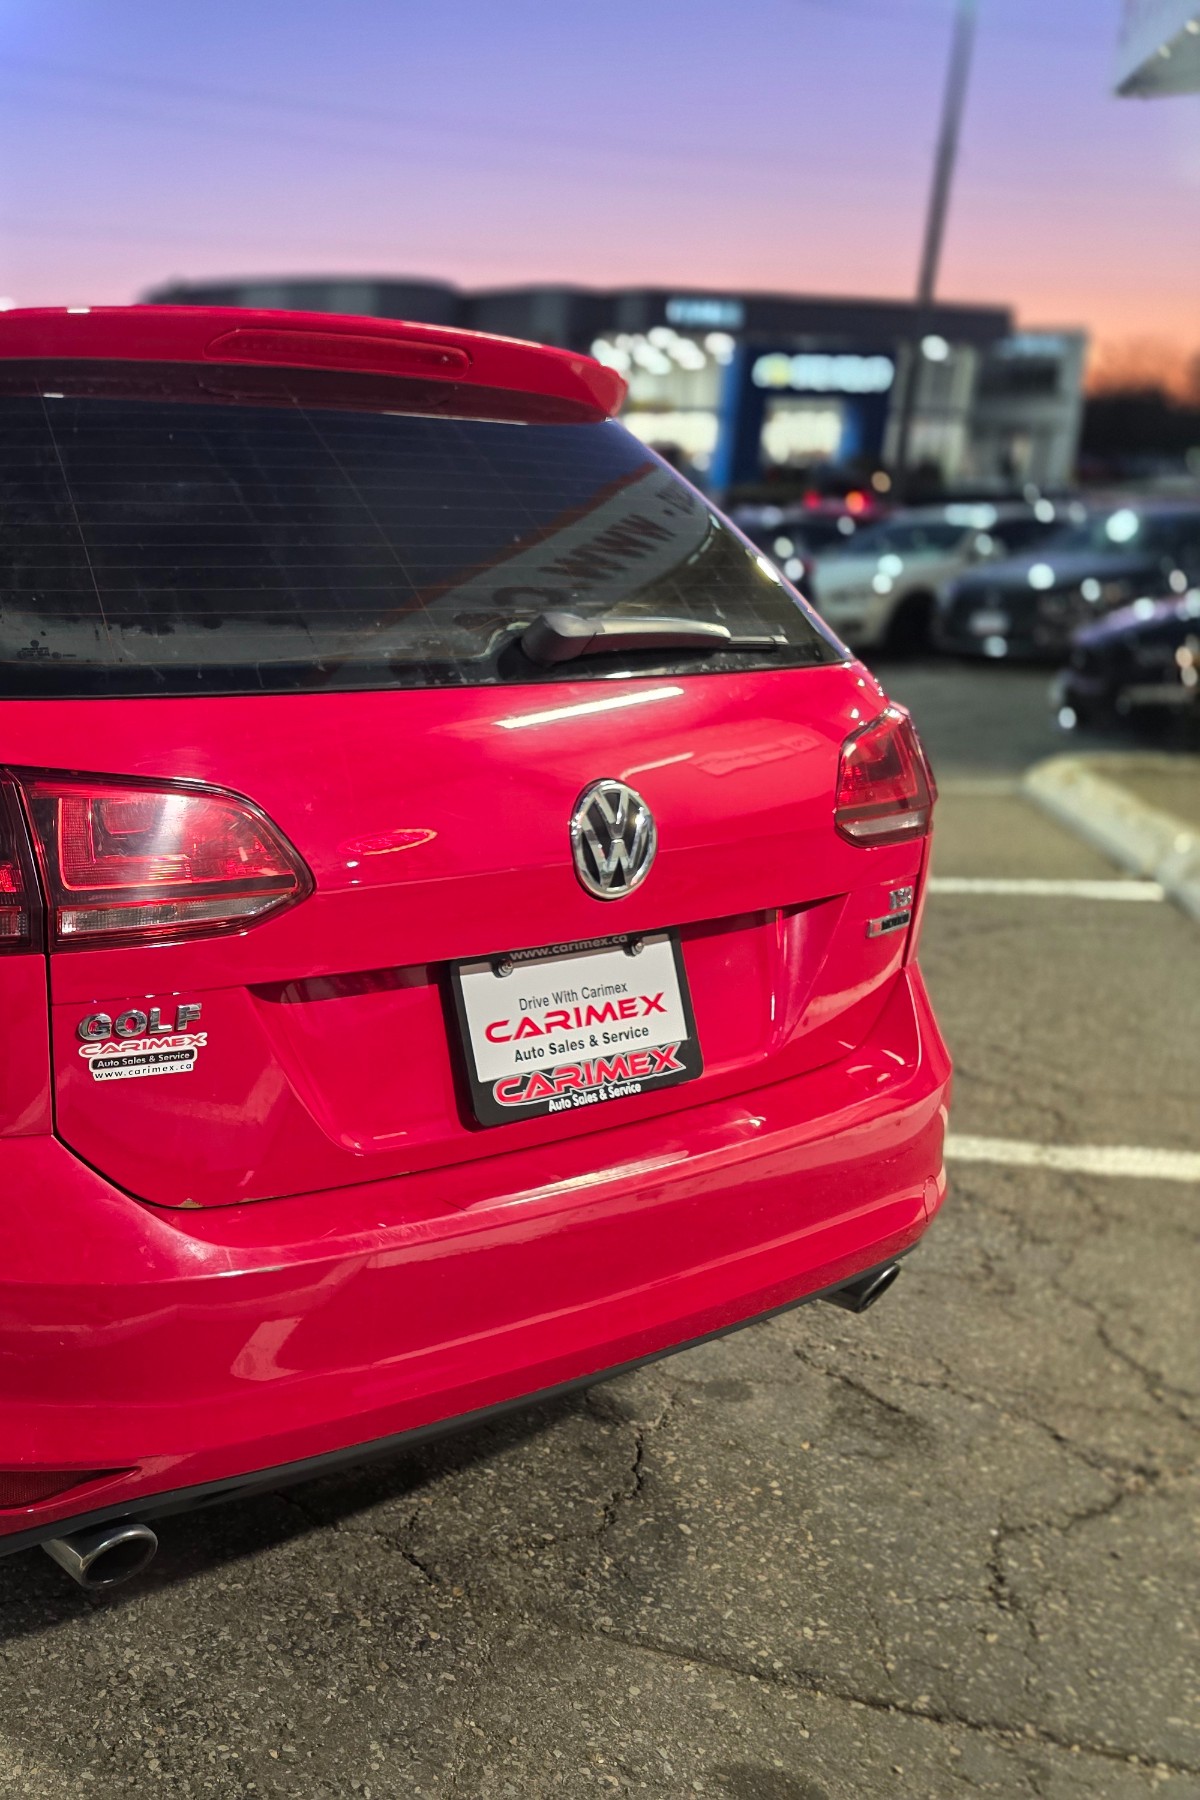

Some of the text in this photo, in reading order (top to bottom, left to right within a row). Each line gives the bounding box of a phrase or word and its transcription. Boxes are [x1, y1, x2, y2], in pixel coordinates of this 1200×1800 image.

[509, 934, 628, 961] www.carimex.ca
[519, 982, 628, 1011] Drive With Carimex
[77, 1003, 202, 1041] GOLF
[484, 992, 667, 1044] CARIMEX
[79, 1034, 207, 1057] CARIMEX
[514, 1025, 649, 1062] Auto Sales & Service
[94, 1062, 193, 1079] www.carimex.ca
[97, 1050, 190, 1068] Auto Sales & Service
[495, 1045, 681, 1104] CARIMEX
[548, 1082, 642, 1112] Auto Sales & Service
